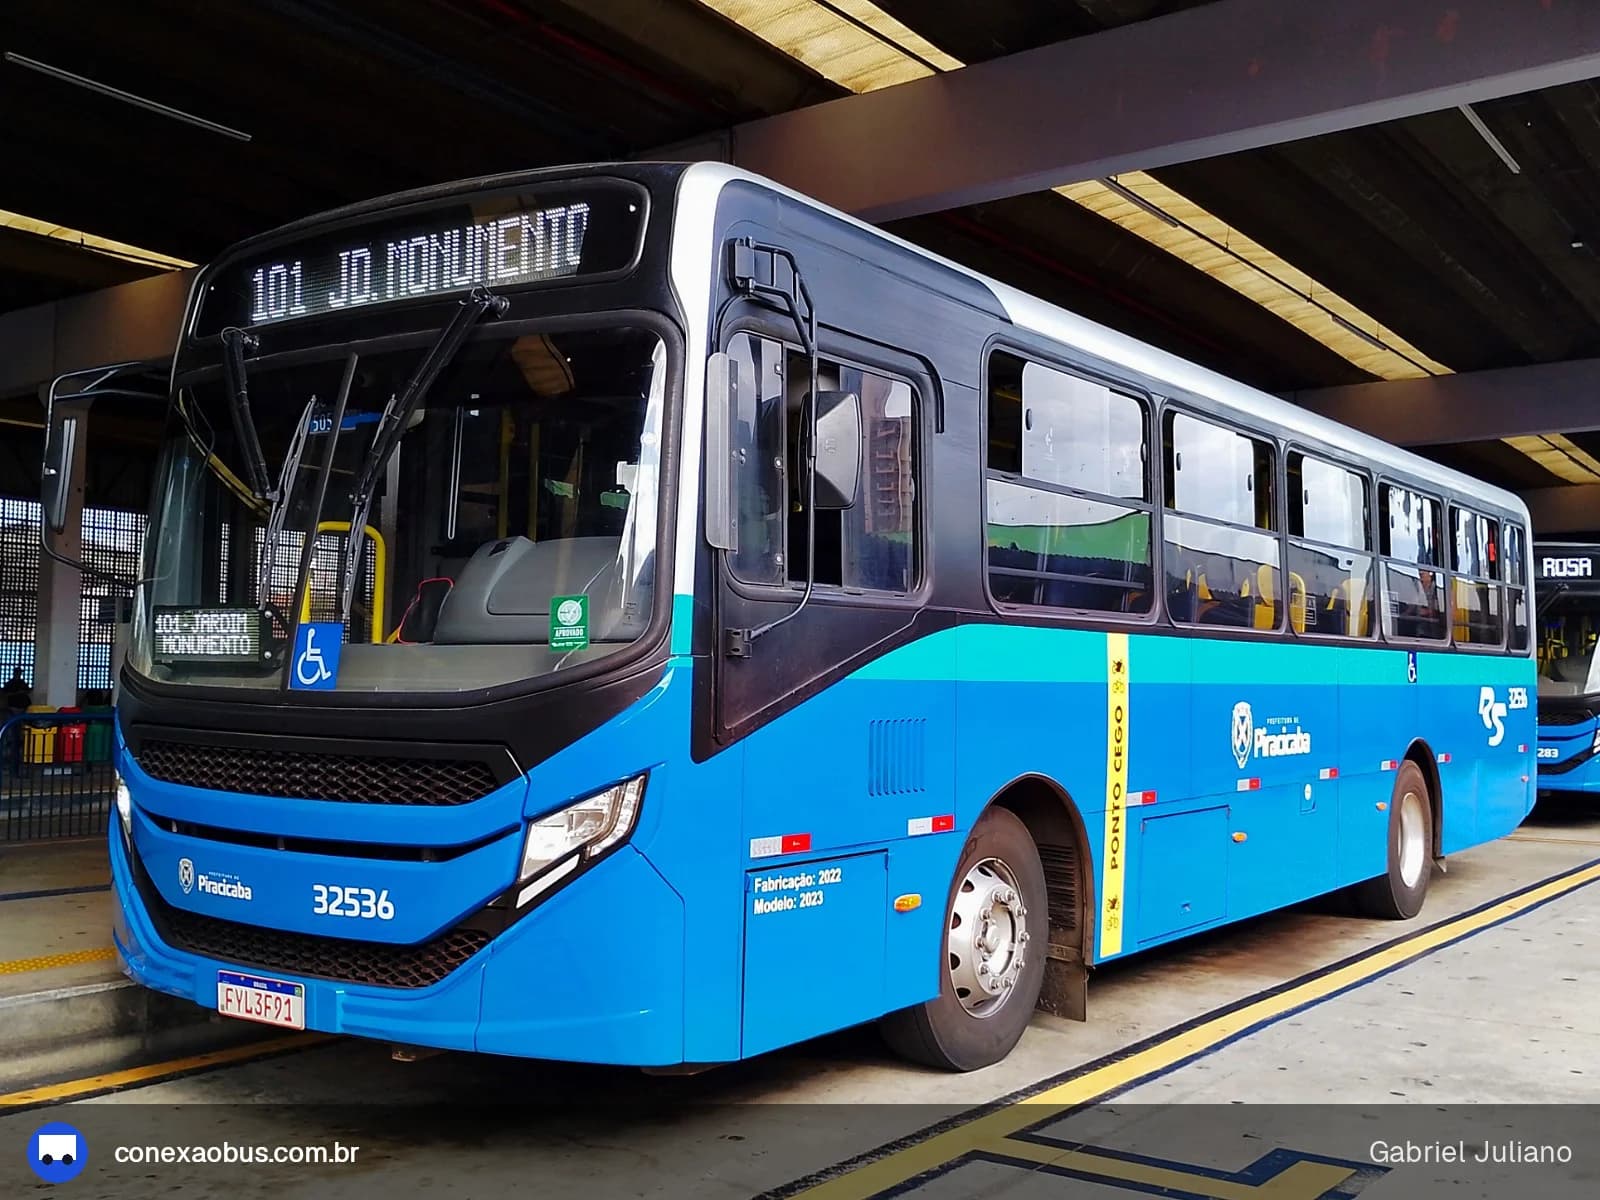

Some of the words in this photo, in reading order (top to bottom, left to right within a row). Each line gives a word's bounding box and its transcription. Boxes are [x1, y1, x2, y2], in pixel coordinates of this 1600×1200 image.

[252, 261, 306, 322] 101
[1542, 557, 1592, 577] ROSA
[162, 635, 251, 655] MONUMENTO
[1113, 705, 1123, 772] CEGO
[1254, 726, 1311, 758] Piracicaba
[1110, 782, 1122, 870] PONTO
[198, 875, 252, 900] Piracicaba
[754, 873, 817, 893] Fabricação:
[818, 867, 842, 884] 2022
[312, 884, 396, 920] 32536
[753, 895, 797, 915] Modelo:
[799, 890, 824, 907] 2023
[225, 988, 292, 1022] FYL3F91
